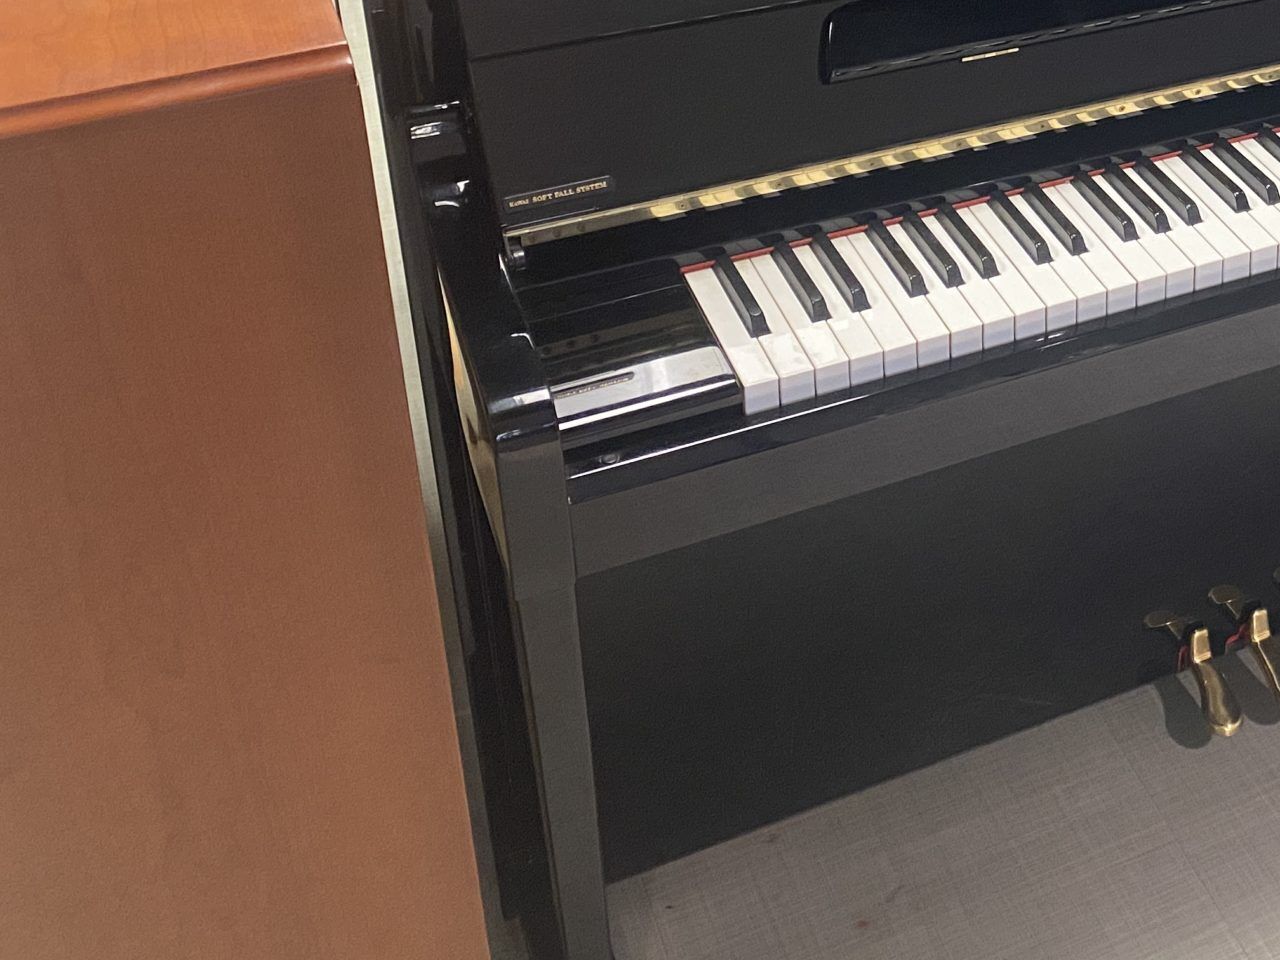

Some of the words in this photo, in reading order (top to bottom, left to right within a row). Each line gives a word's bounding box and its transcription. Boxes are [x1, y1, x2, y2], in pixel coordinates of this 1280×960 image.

[532, 192, 553, 203] SOFT
[554, 188, 575, 199] FALL
[575, 181, 608, 194] SYSTEM
